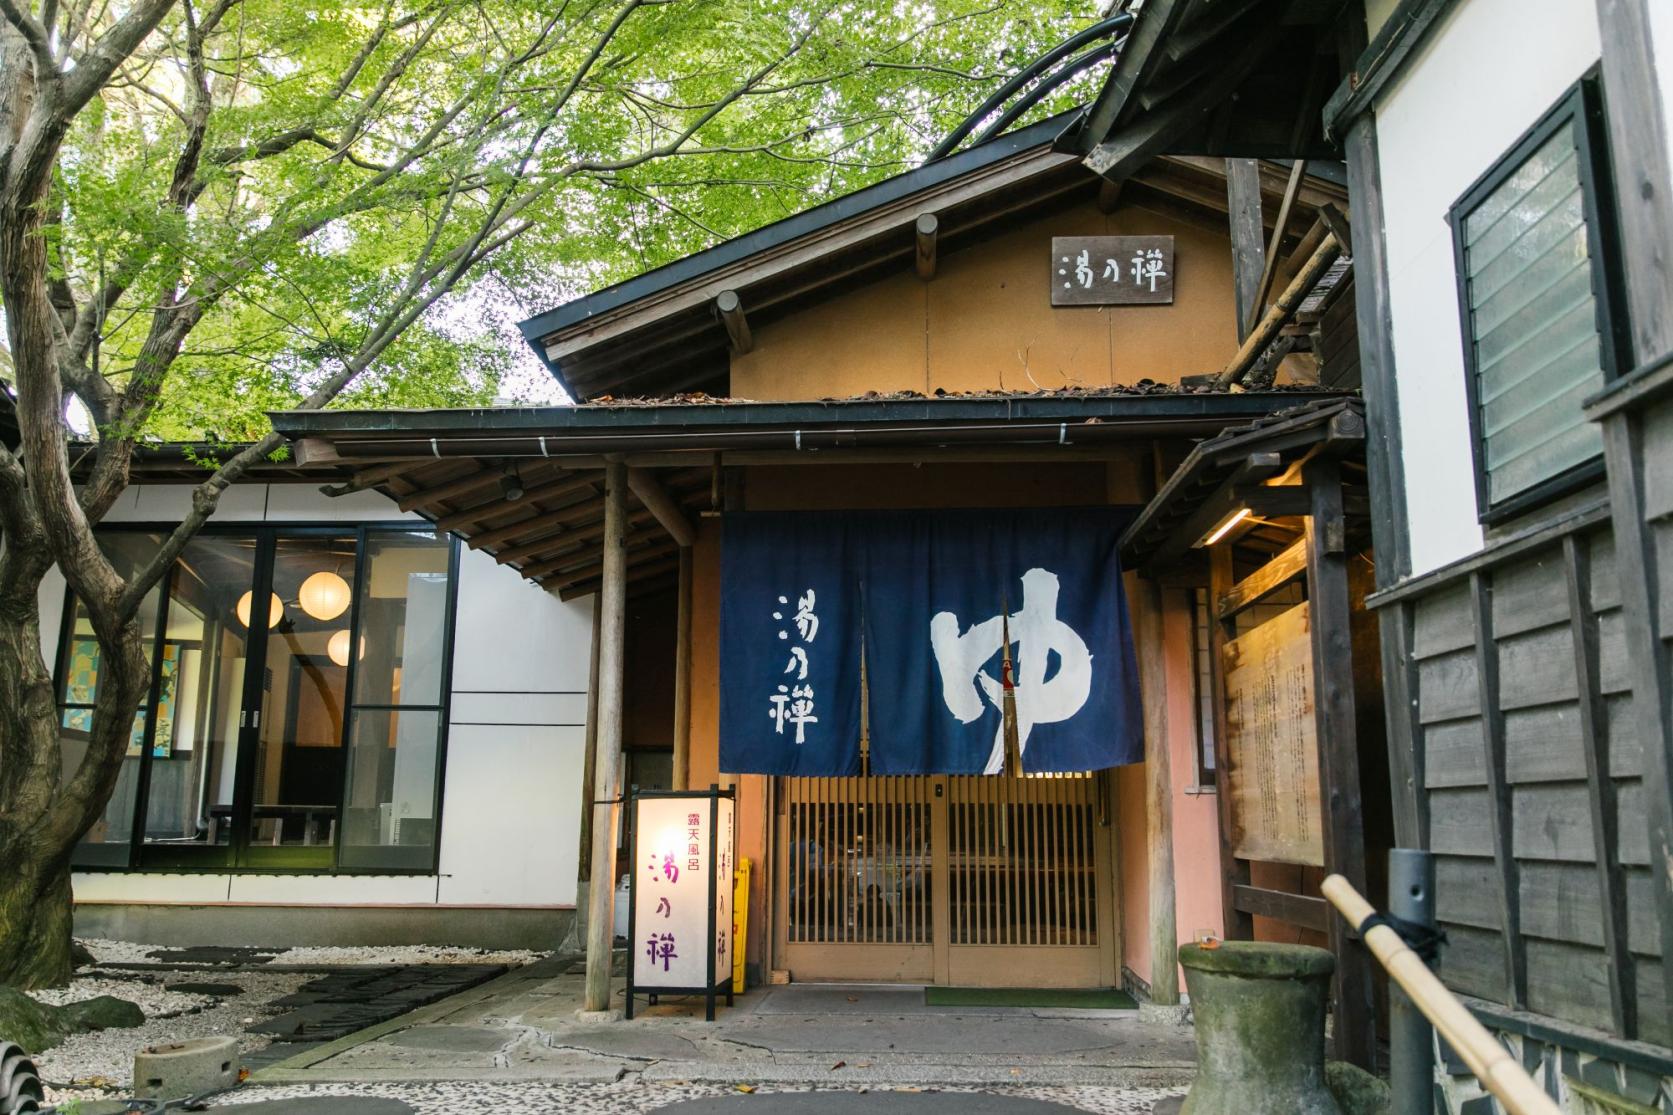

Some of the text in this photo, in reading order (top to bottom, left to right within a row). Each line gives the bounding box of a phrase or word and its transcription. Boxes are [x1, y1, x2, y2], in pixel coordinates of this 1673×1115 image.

[930, 567, 1094, 775] ゆ
[687, 812, 700, 871] 露天風呂
